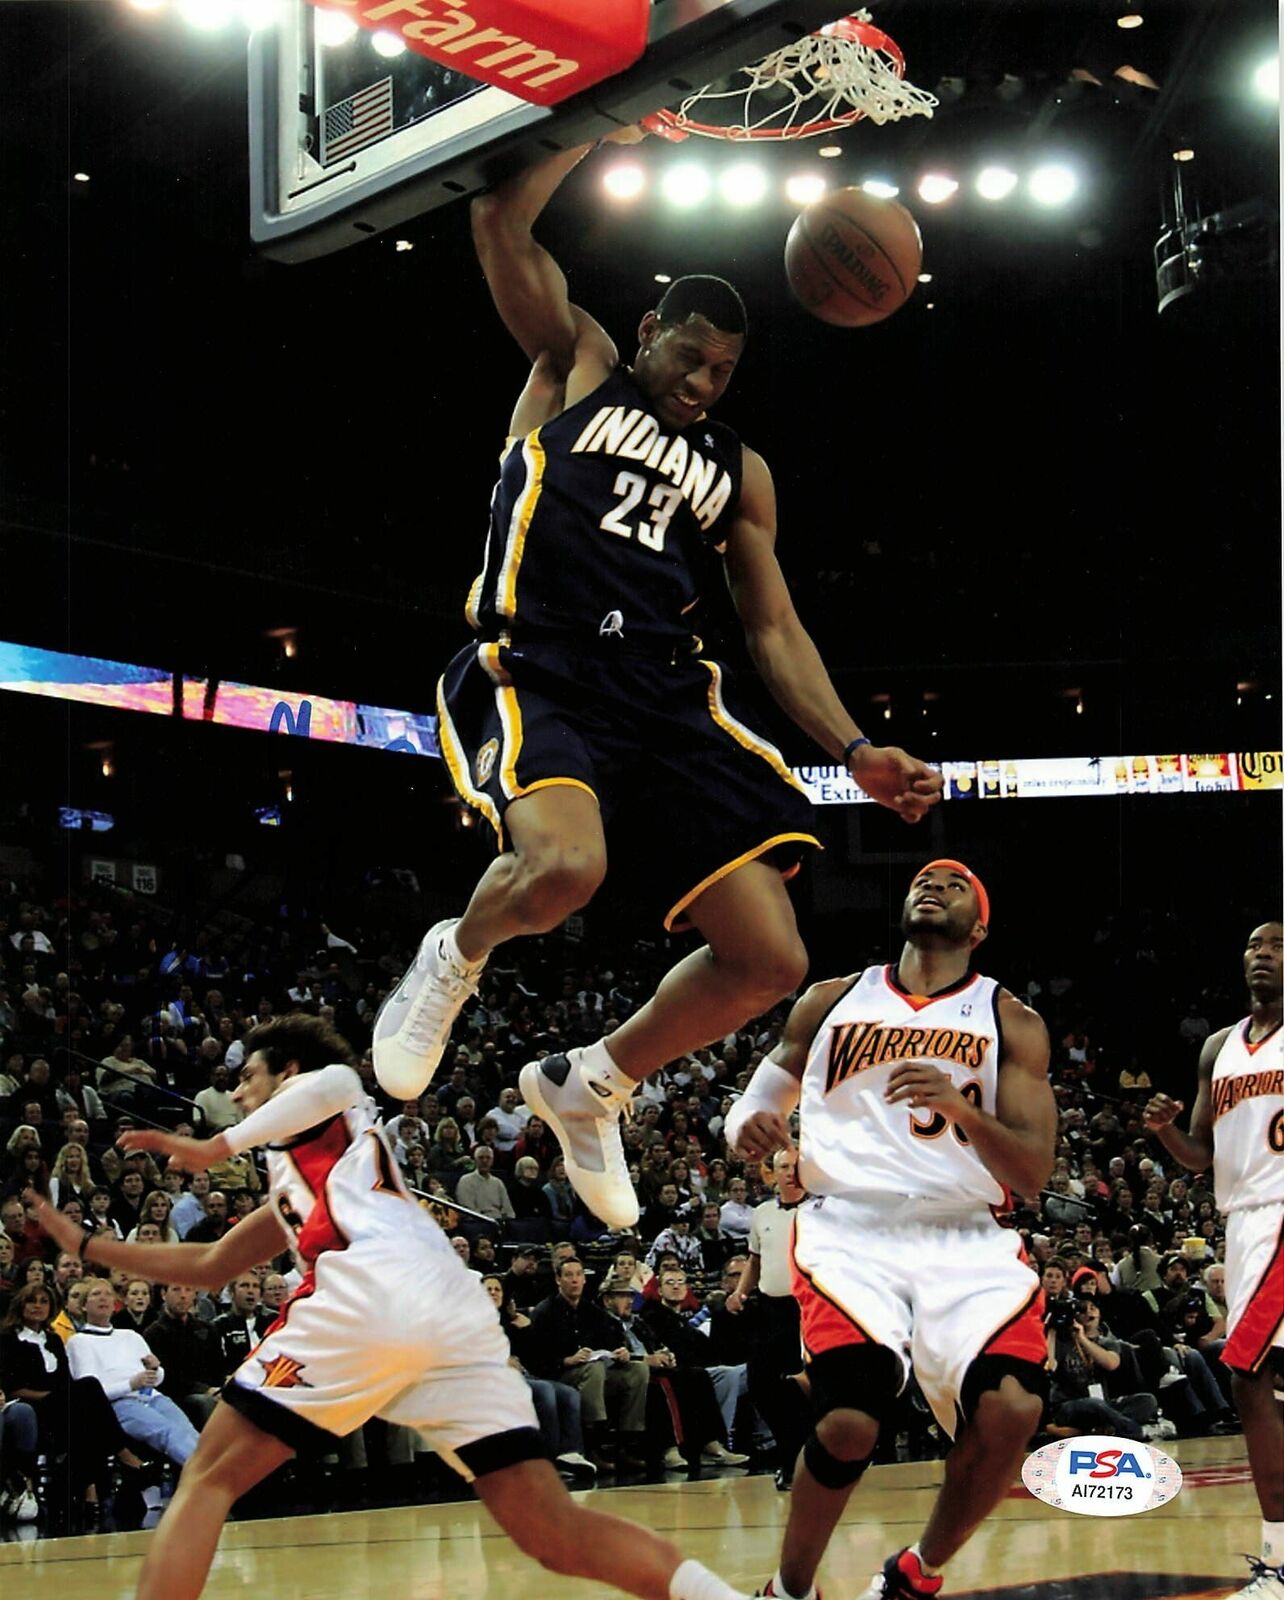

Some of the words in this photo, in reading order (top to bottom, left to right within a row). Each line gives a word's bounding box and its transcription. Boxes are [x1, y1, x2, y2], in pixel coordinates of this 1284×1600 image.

[361, 0, 579, 88] Farm
[570, 406, 732, 531] INDIANA
[599, 470, 683, 552] 23
[823, 1019, 993, 1098] WARRIORS
